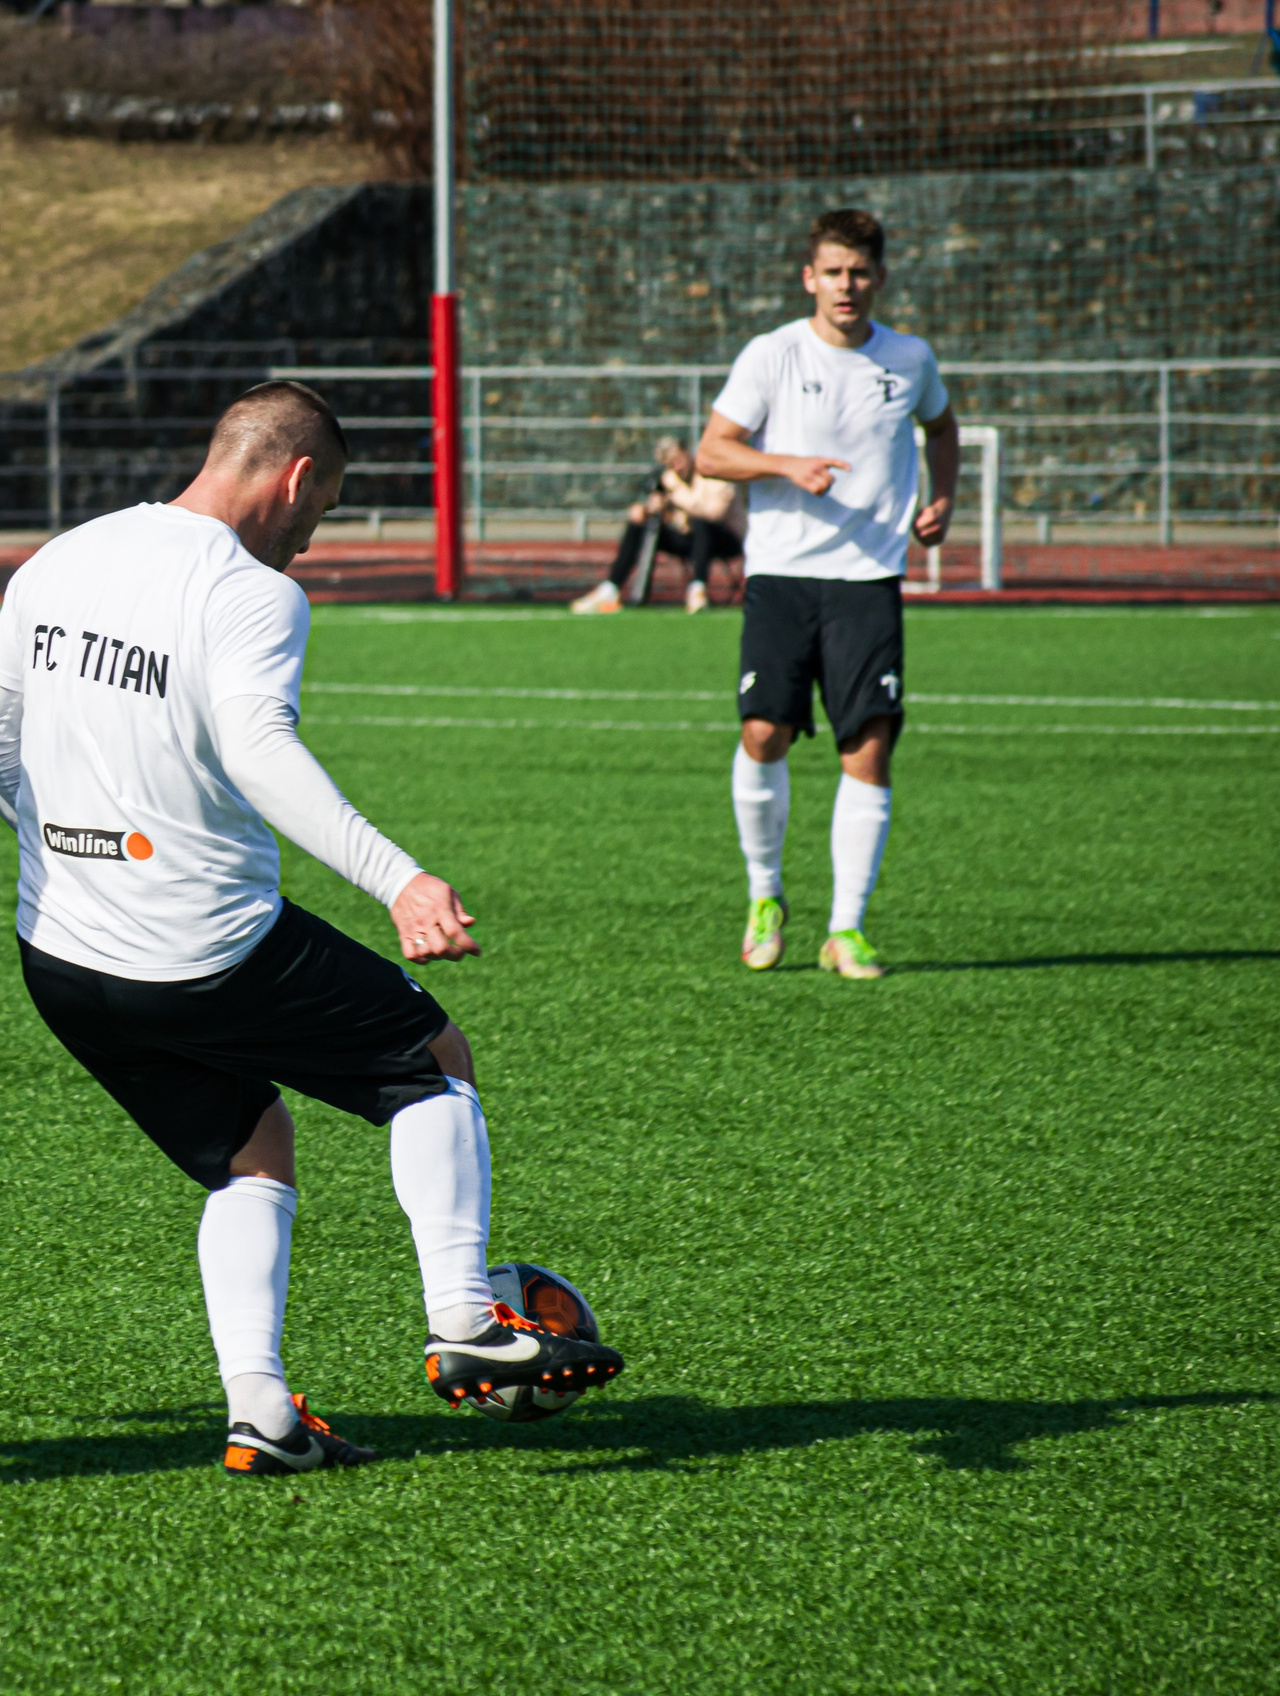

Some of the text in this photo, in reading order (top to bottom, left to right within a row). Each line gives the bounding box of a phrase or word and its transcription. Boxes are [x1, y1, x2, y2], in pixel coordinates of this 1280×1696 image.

[32, 624, 170, 699] FC TITAN
[46, 828, 118, 856] Winline
